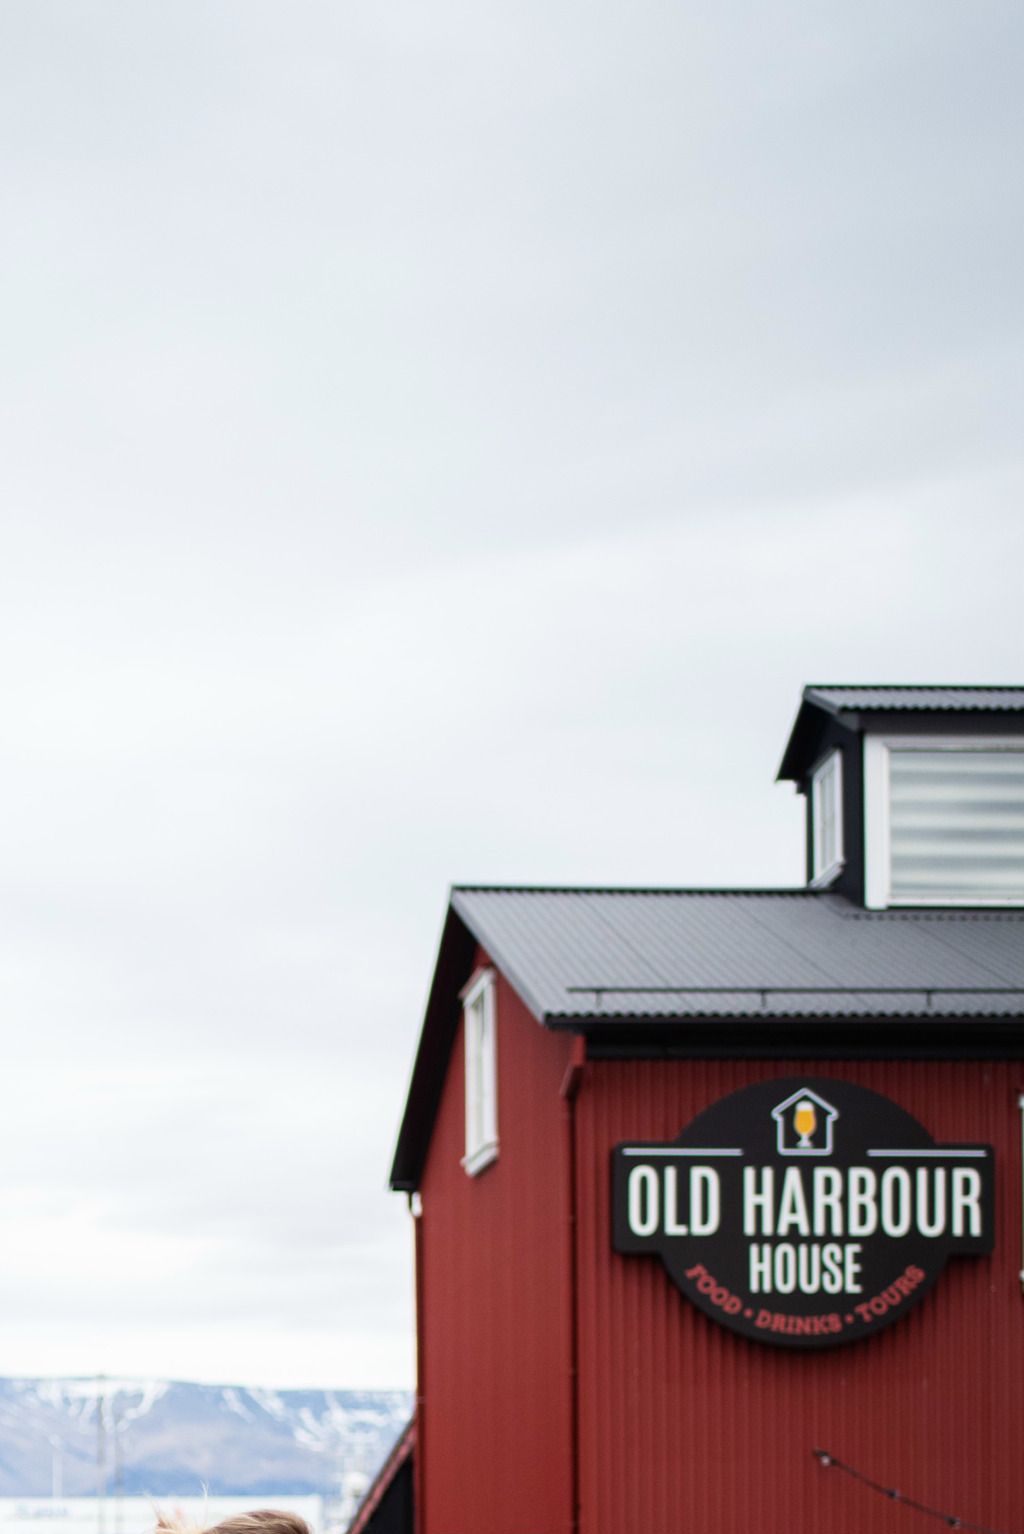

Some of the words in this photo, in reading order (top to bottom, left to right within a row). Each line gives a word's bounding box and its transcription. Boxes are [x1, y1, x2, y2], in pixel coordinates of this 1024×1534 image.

[628, 1164, 720, 1236] OLD
[743, 1166, 982, 1238] HARBOUR
[684, 1263, 743, 1315] FOOD
[754, 1308, 843, 1335] DRINKS
[854, 1264, 925, 1322] TOURS
[749, 1243, 862, 1294] HOUSE
